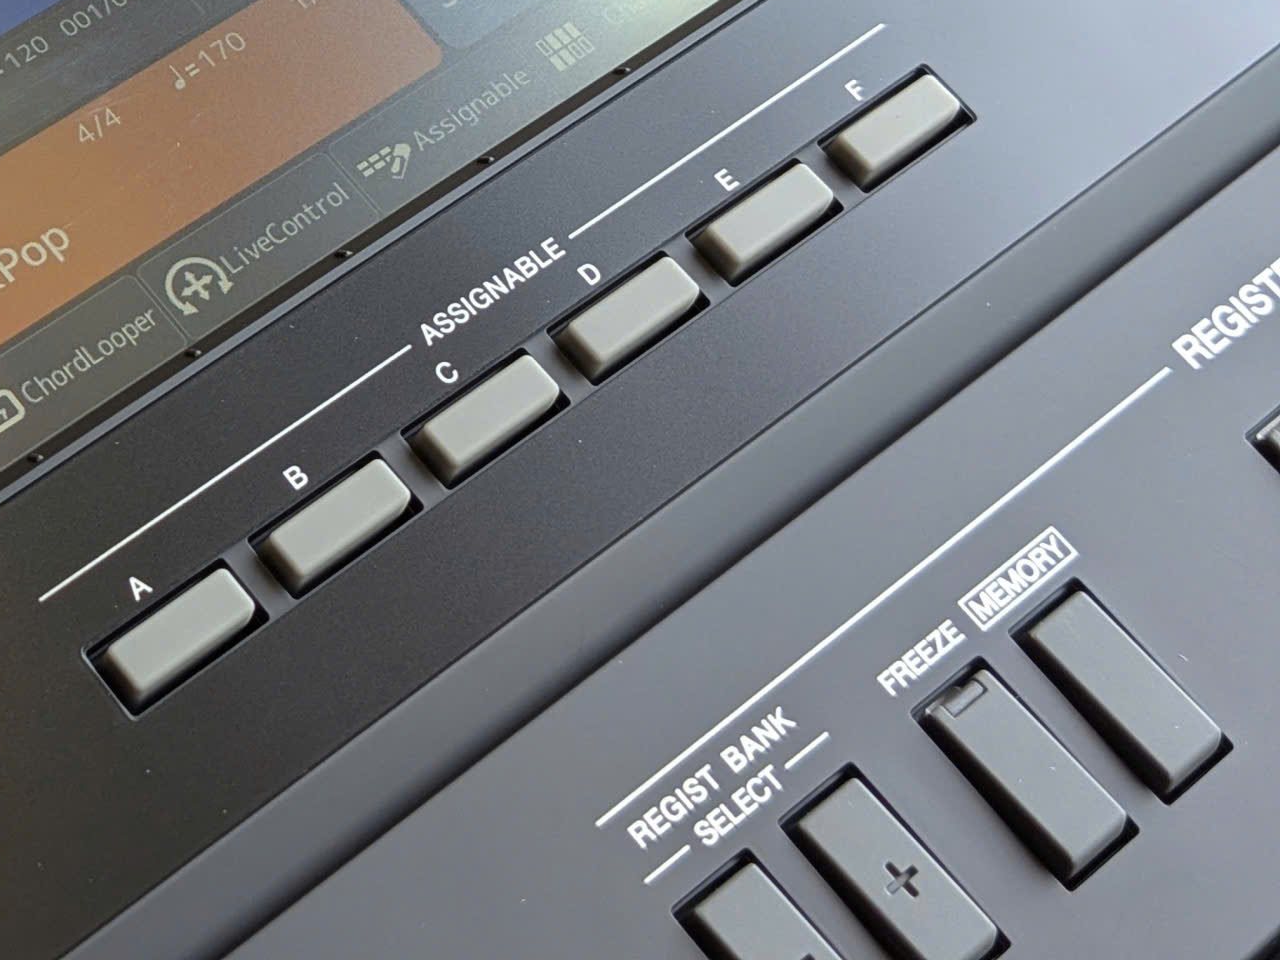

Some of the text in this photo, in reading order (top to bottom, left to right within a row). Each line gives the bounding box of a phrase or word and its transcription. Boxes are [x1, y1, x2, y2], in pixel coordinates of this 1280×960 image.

[77, 106, 122, 145] 4/4
[412, 61, 533, 152] Assignable
[844, 79, 866, 102] F
[714, 169, 740, 193] E
[220, 182, 351, 276] LiveControl
[418, 237, 566, 348] ASSIGNABLE
[578, 263, 602, 288] D
[21, 305, 157, 405] ChordLooper
[435, 362, 460, 385] C
[283, 465, 309, 491] B
[128, 576, 153, 602] A
[967, 534, 1067, 622] MEMORY
[877, 619, 968, 696] FREEZE
[626, 707, 797, 849] REGIST BANK
[693, 764, 783, 848] SELECT
